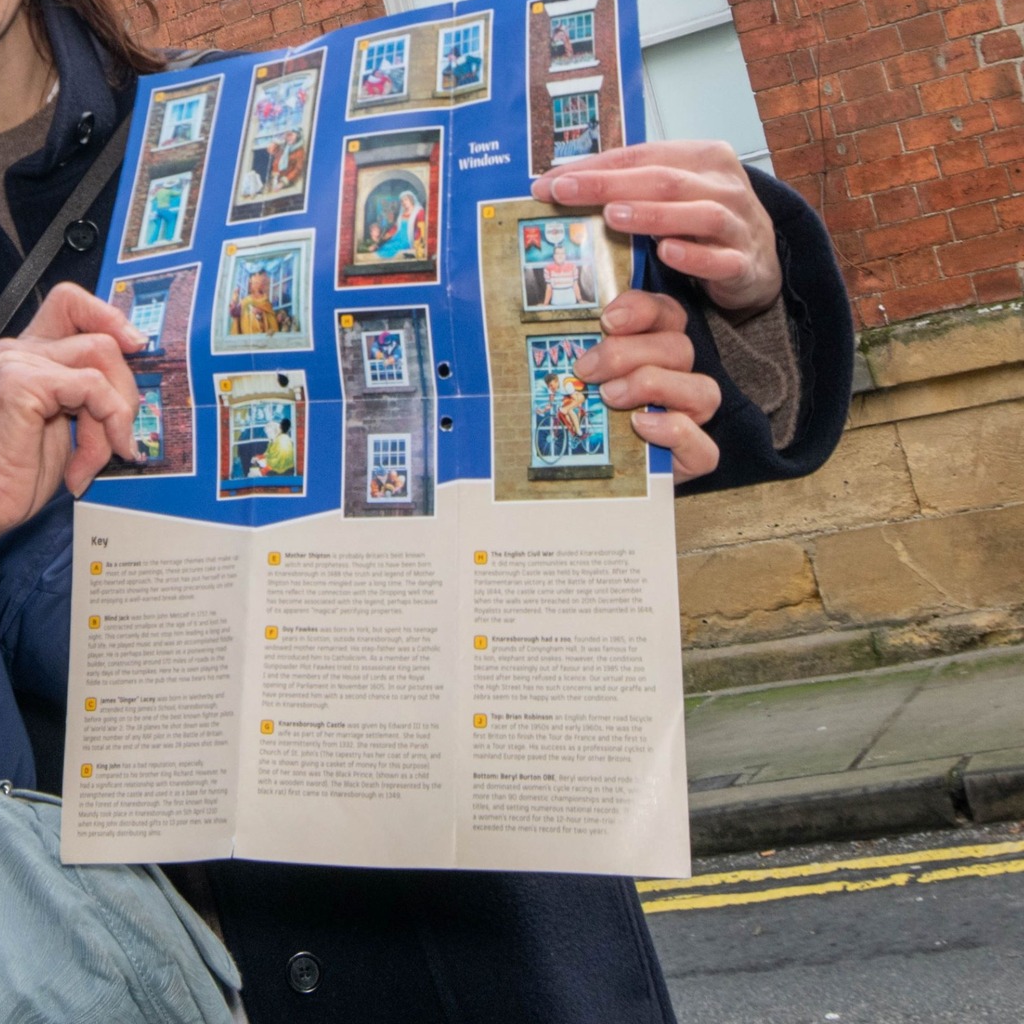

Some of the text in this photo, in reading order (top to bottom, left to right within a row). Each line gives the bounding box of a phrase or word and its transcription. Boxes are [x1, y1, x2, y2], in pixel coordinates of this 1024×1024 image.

[468, 141, 499, 154] Town
[458, 154, 510, 170] Windows
[91, 536, 108, 548] Key
[308, 551, 331, 560] Shipton
[504, 549, 526, 559] English
[104, 614, 117, 622] Blind
[282, 625, 294, 634] Guy
[491, 635, 540, 644] Knaresborough
[100, 696, 116, 704] James
[140, 694, 156, 704] Lacey
[278, 720, 325, 730] Knaresborough
[96, 762, 108, 771] King
[500, 772, 518, 782] Beryl
